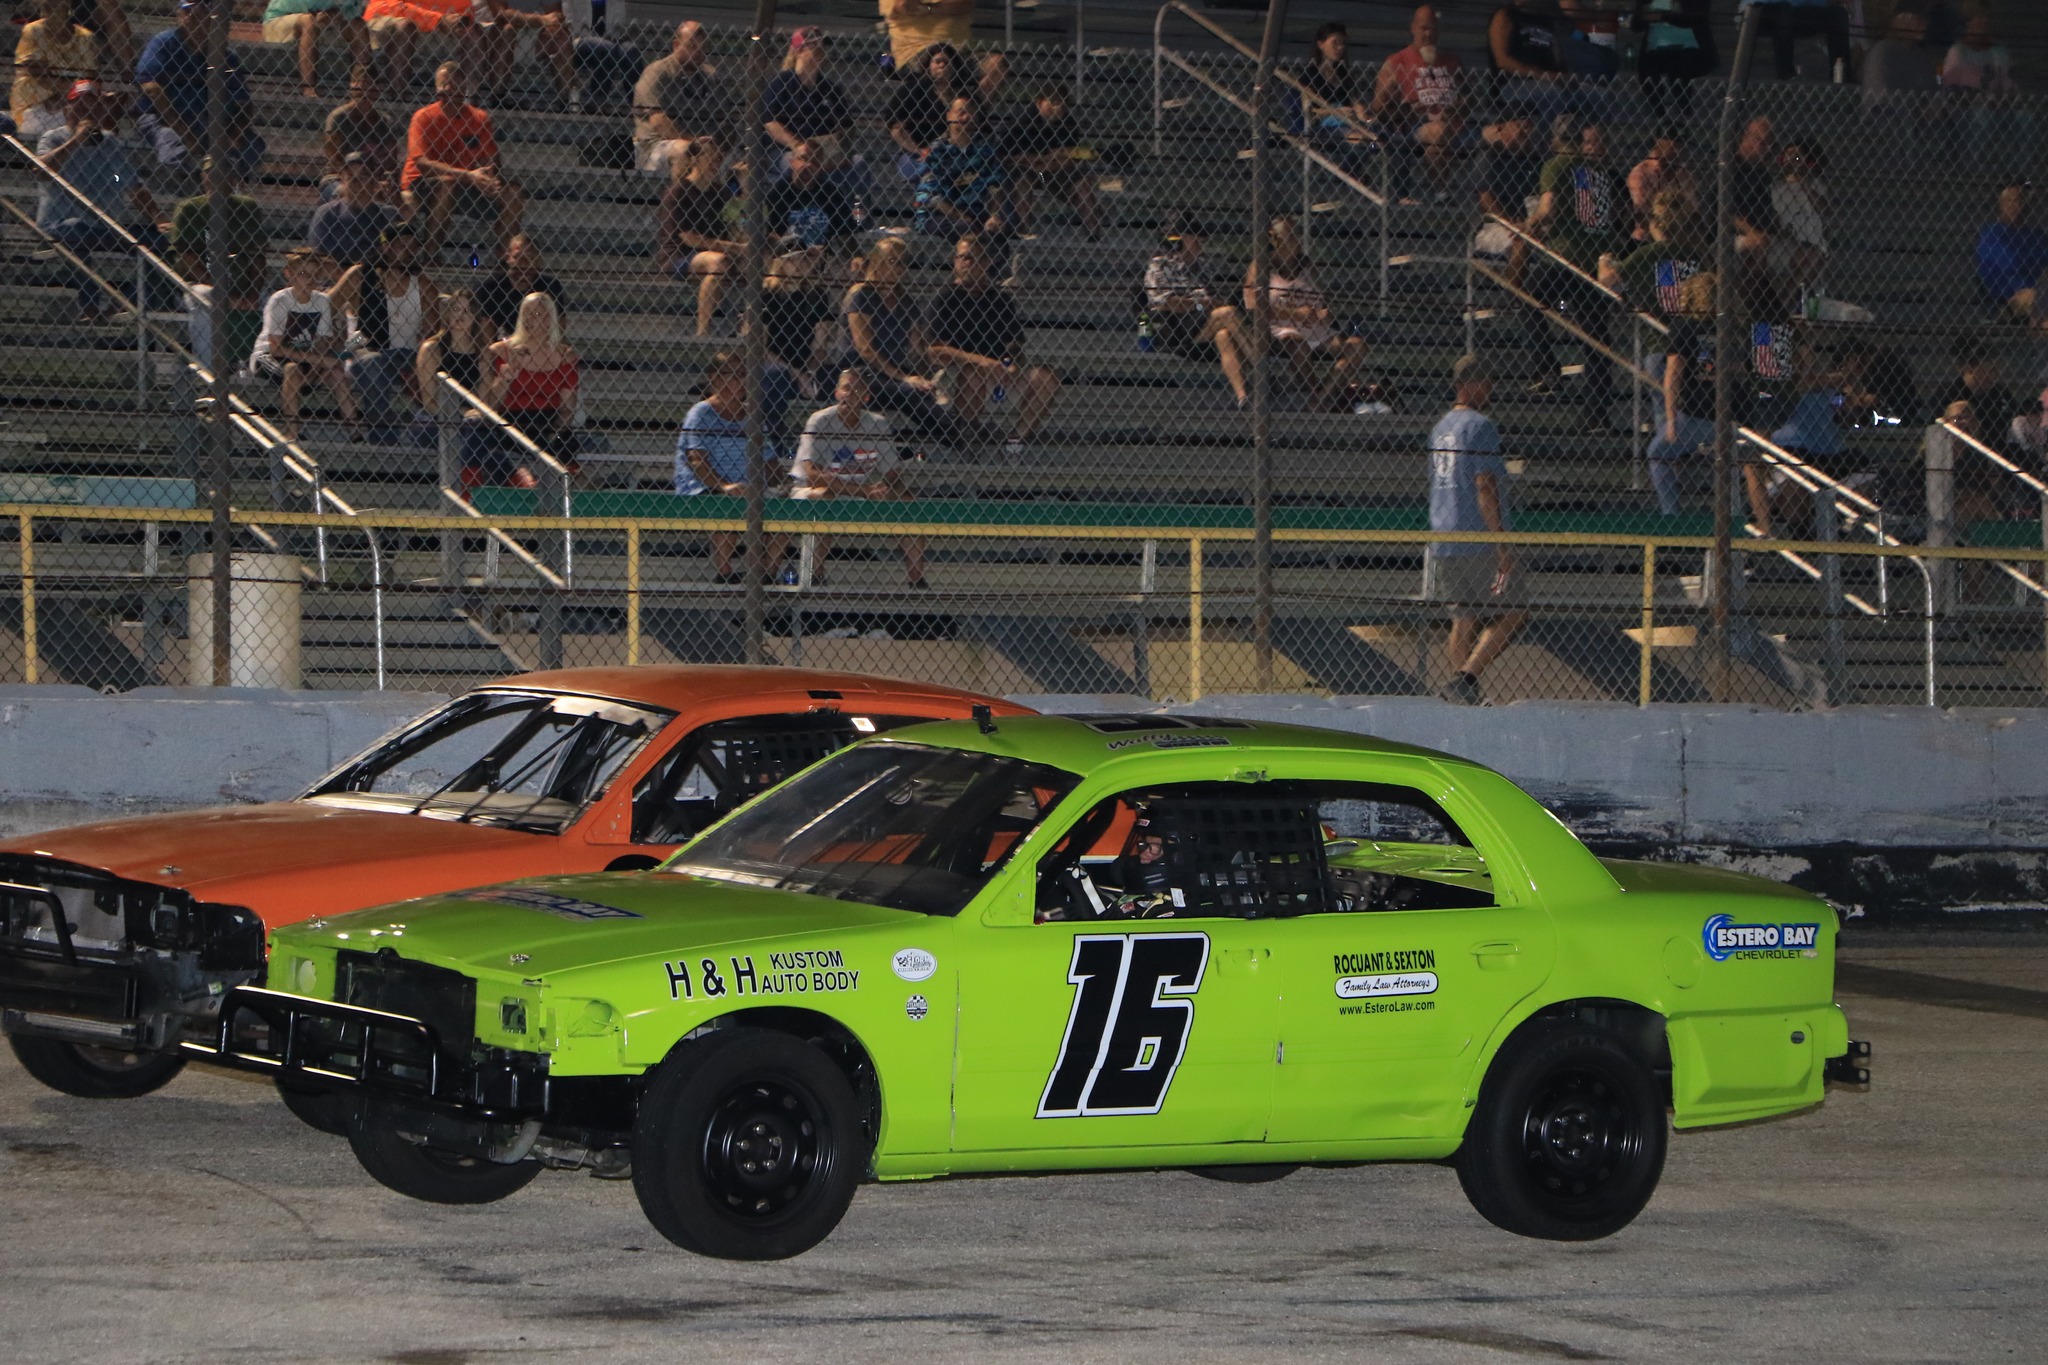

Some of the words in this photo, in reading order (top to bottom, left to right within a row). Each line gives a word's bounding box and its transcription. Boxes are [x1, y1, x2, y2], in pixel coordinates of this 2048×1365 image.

[1717, 926, 1780, 947] ESTERO
[1783, 926, 1816, 945] BAY
[769, 950, 844, 970] KUSTOM
[1334, 952, 1384, 974] ROCUANT
[1385, 951, 1394, 970] &
[1394, 950, 1436, 970] SEXTON
[1735, 950, 1802, 960] CHEVROLET
[664, 960, 693, 999] H
[702, 958, 726, 996] &
[730, 956, 758, 994] H
[761, 972, 808, 994] AUTO
[812, 971, 860, 992] BODY
[1343, 979, 1371, 993] Family
[1372, 977, 1391, 990] Law
[1393, 977, 1430, 990] Attorneys
[1339, 1001, 1435, 1015] www.EsteroLaw.com
[1034, 931, 1211, 1119] 16
